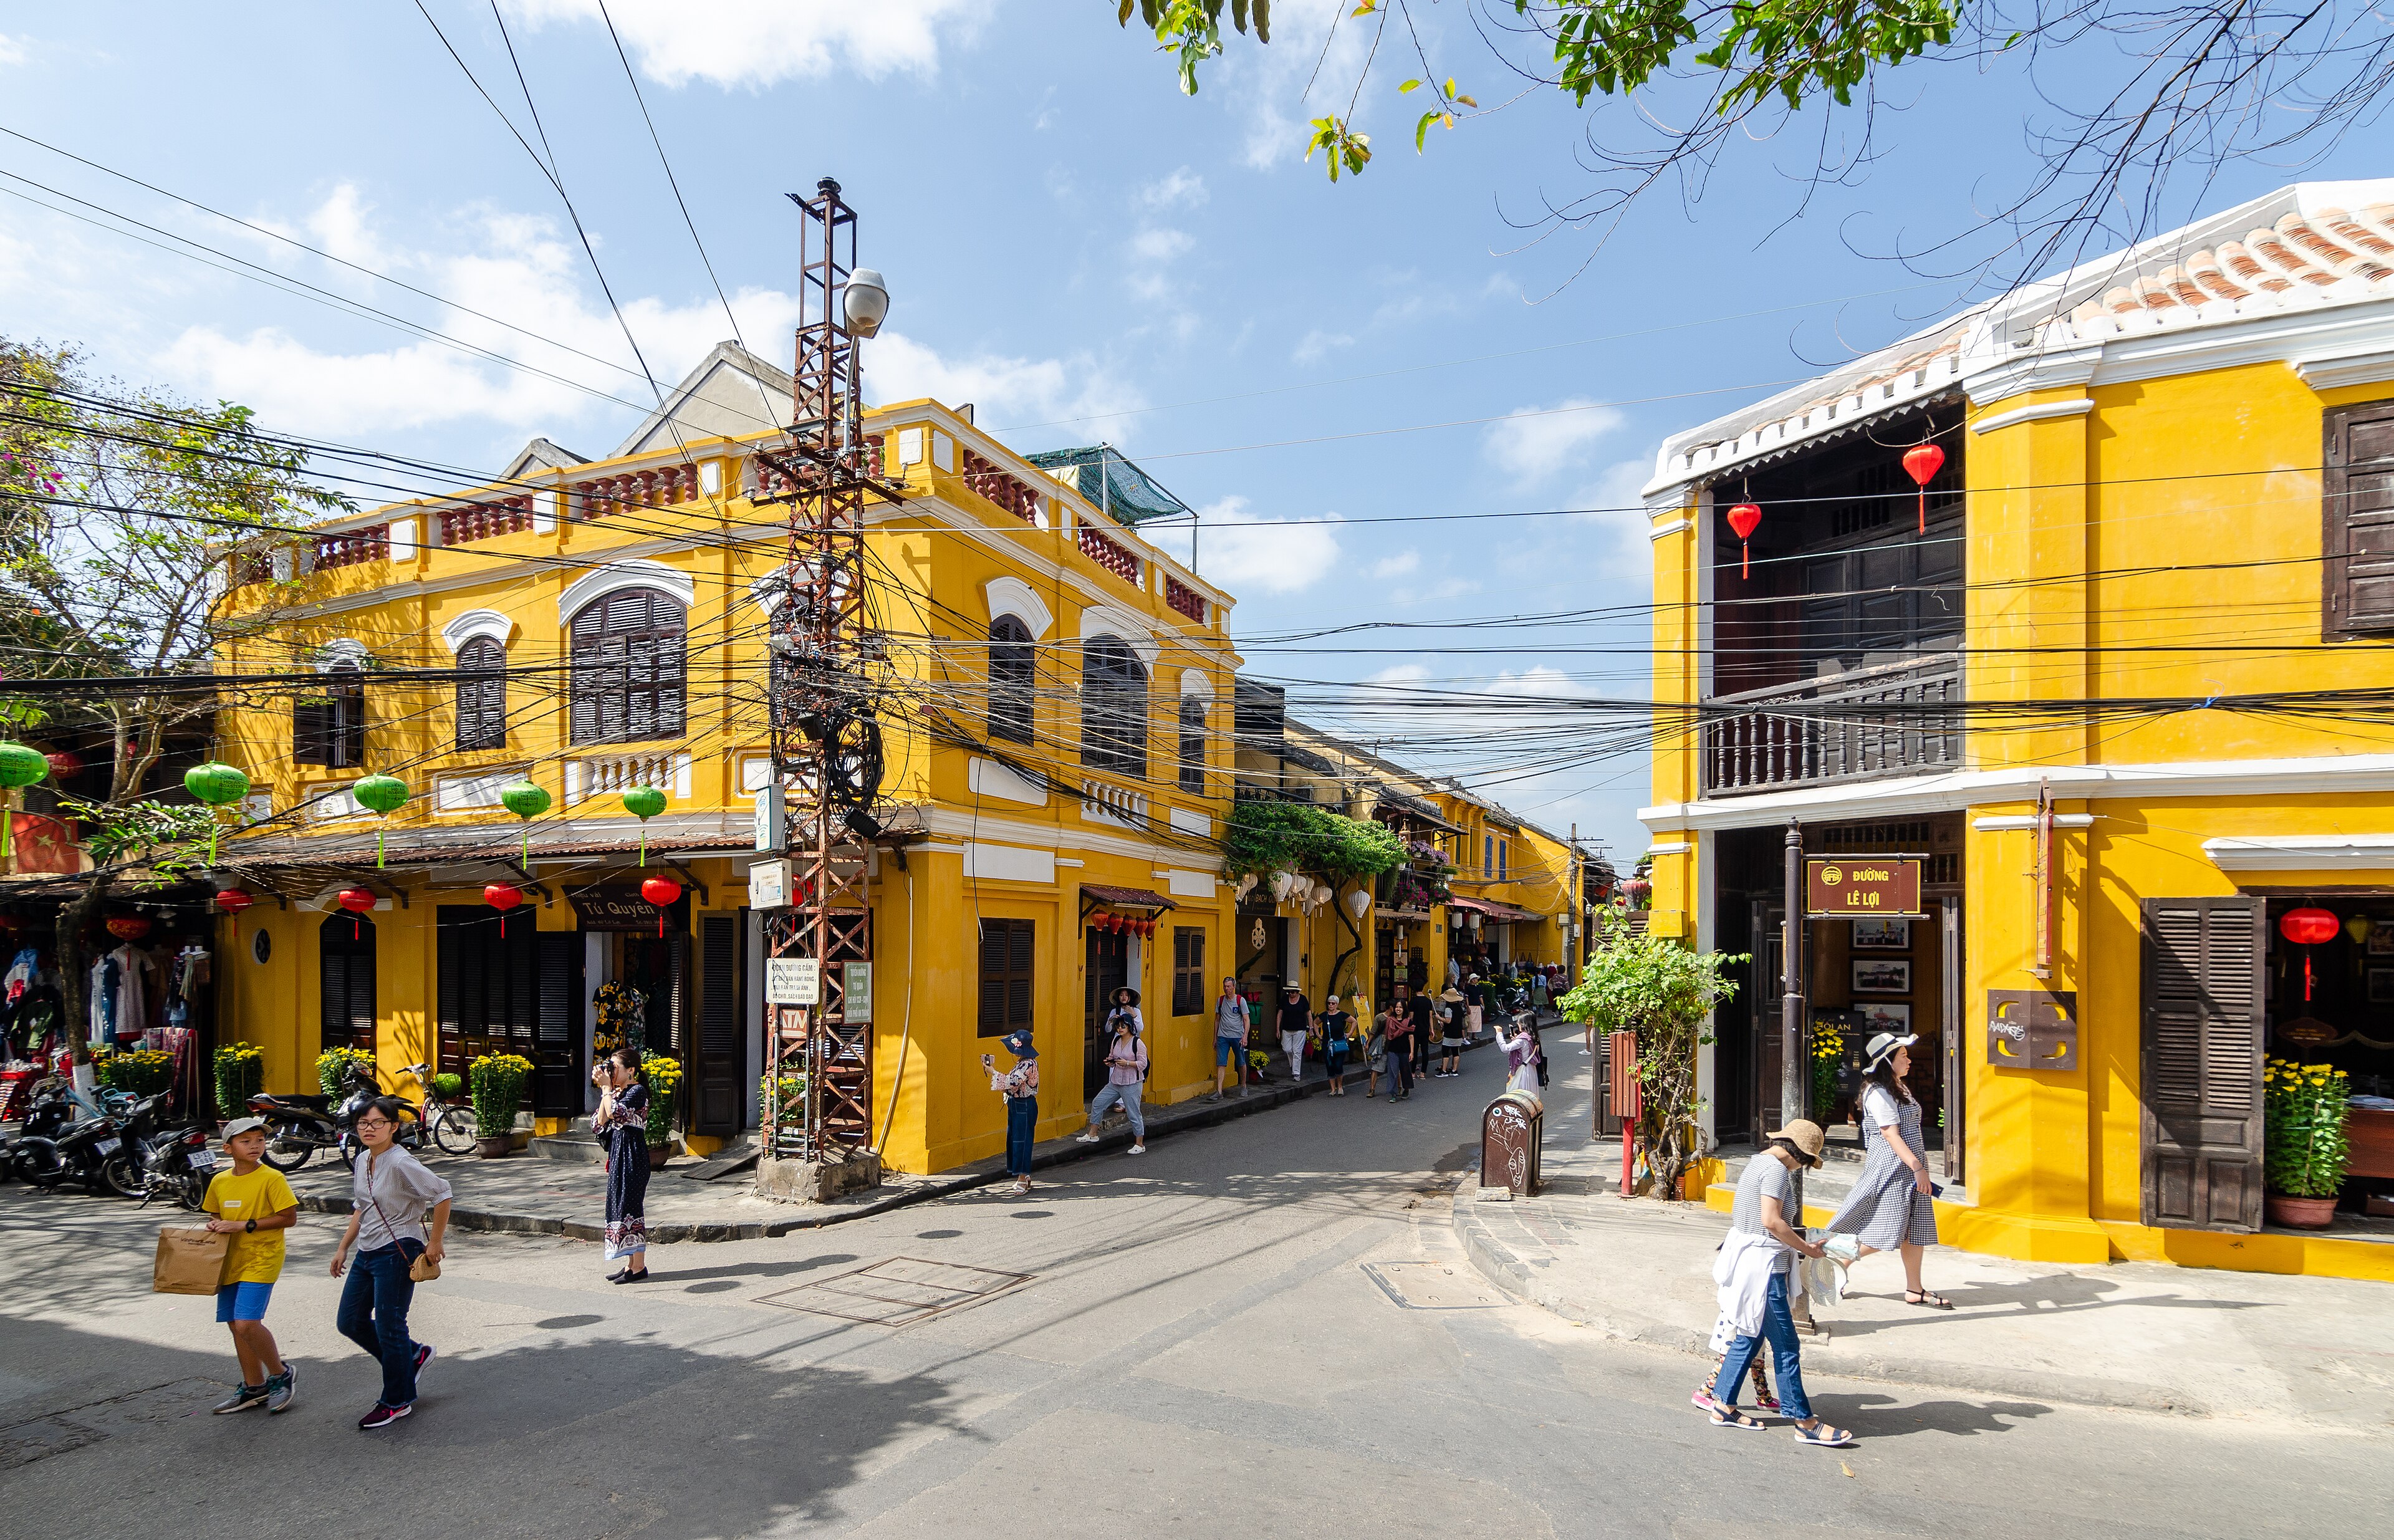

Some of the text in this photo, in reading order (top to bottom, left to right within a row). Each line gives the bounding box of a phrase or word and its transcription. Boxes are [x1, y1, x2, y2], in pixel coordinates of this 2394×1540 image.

[1853, 867, 1889, 881] ĐƯỜNG
[1847, 890, 1880, 908] LÊ LỢI
[582, 901, 655, 918] Tú Quyên
[772, 1010, 807, 1029] ATM
